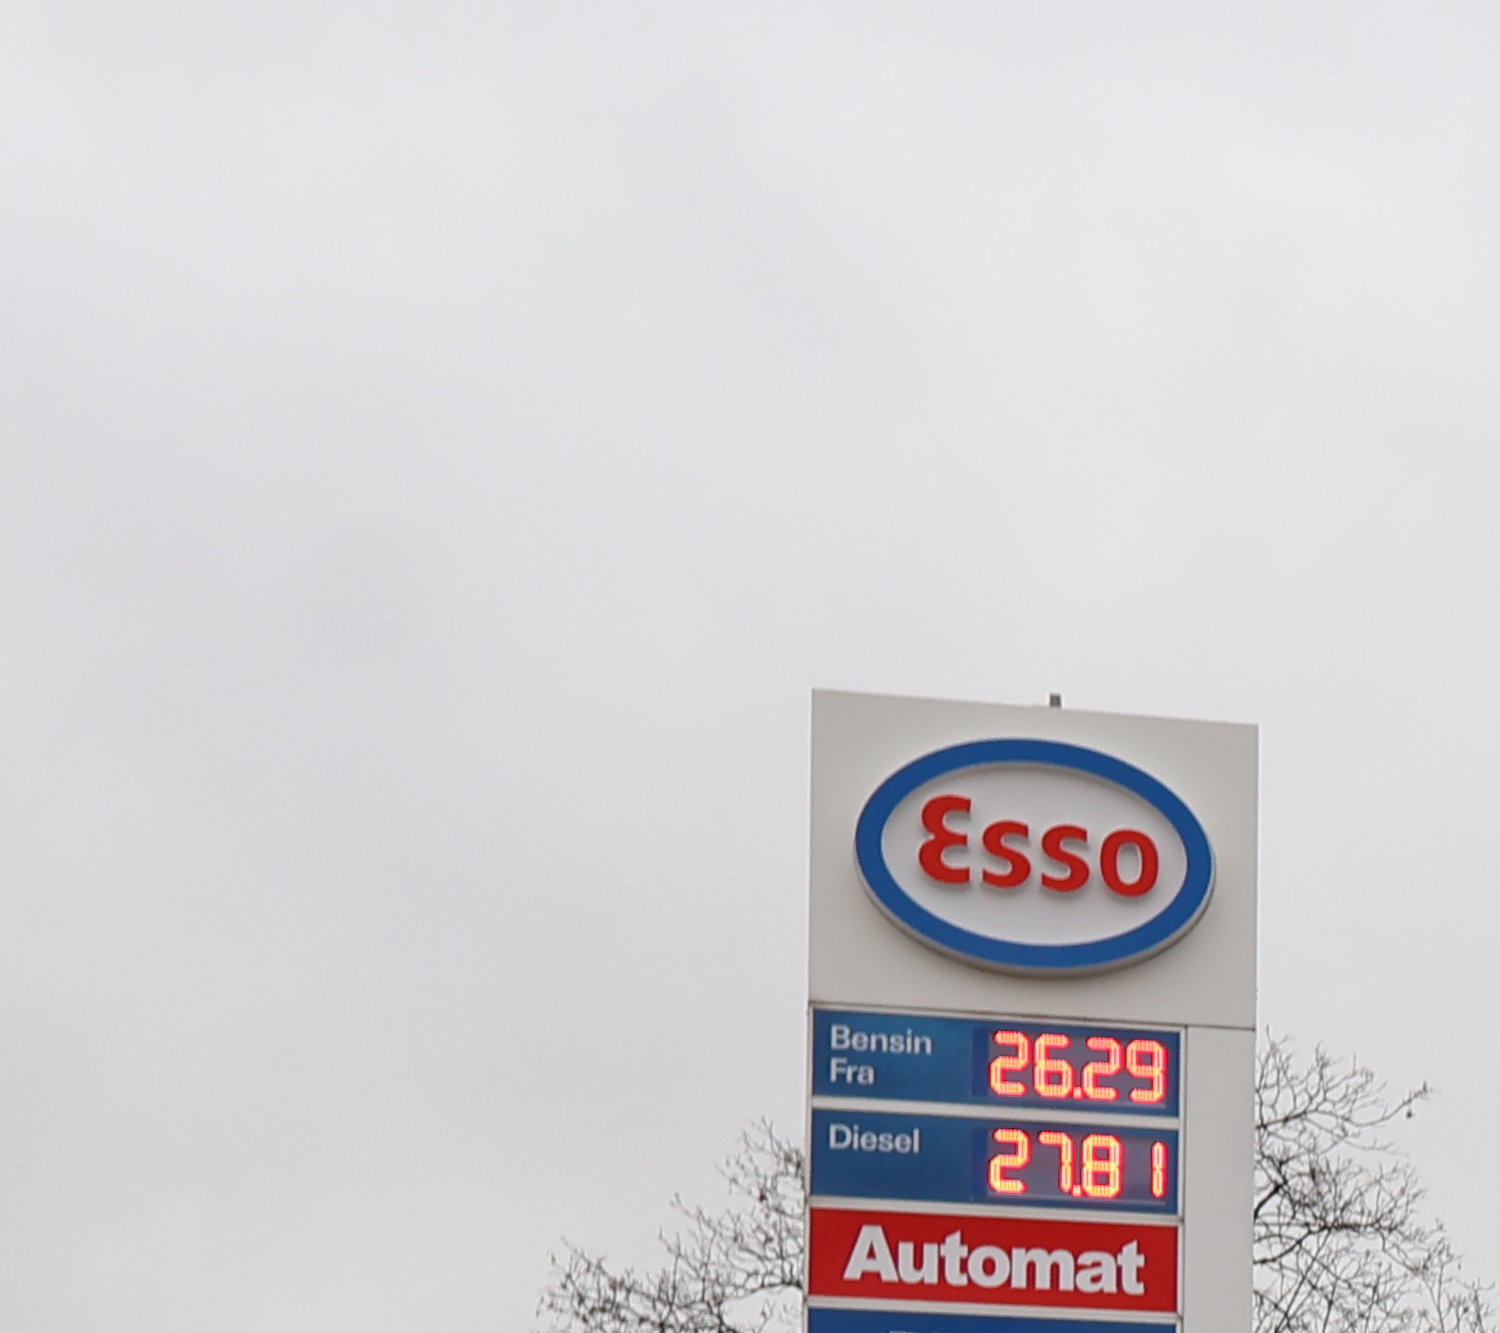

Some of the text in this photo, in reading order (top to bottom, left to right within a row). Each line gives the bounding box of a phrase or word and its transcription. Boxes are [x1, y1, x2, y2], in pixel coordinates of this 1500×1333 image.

[829, 1060, 874, 1086] Fra
[830, 1025, 1168, 1102] Bensin 26.29
[828, 1123, 1166, 1198] Diesel 27.81
[843, 1225, 1145, 1295] Automat
